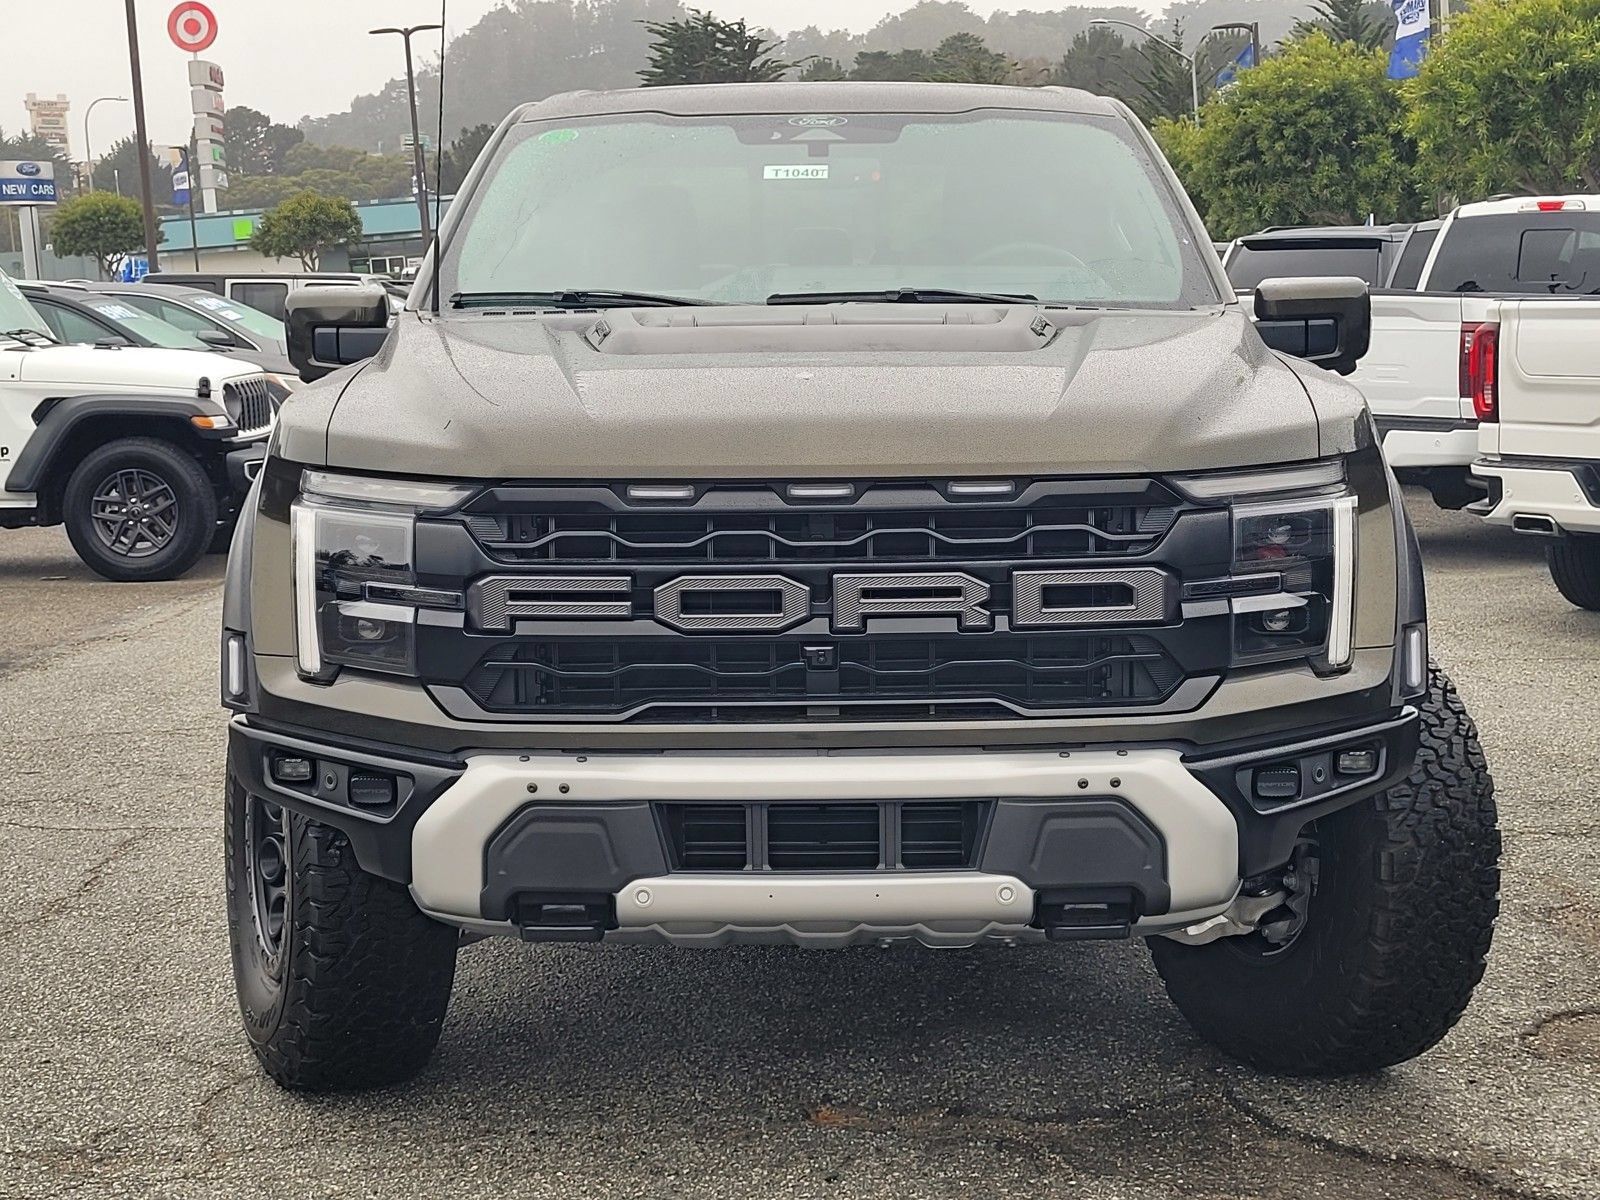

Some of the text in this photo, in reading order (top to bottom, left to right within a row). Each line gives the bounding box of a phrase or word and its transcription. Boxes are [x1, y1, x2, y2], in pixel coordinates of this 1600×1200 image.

[2, 184, 55, 195] NEW CARS
[470, 566, 1168, 632] FORD
